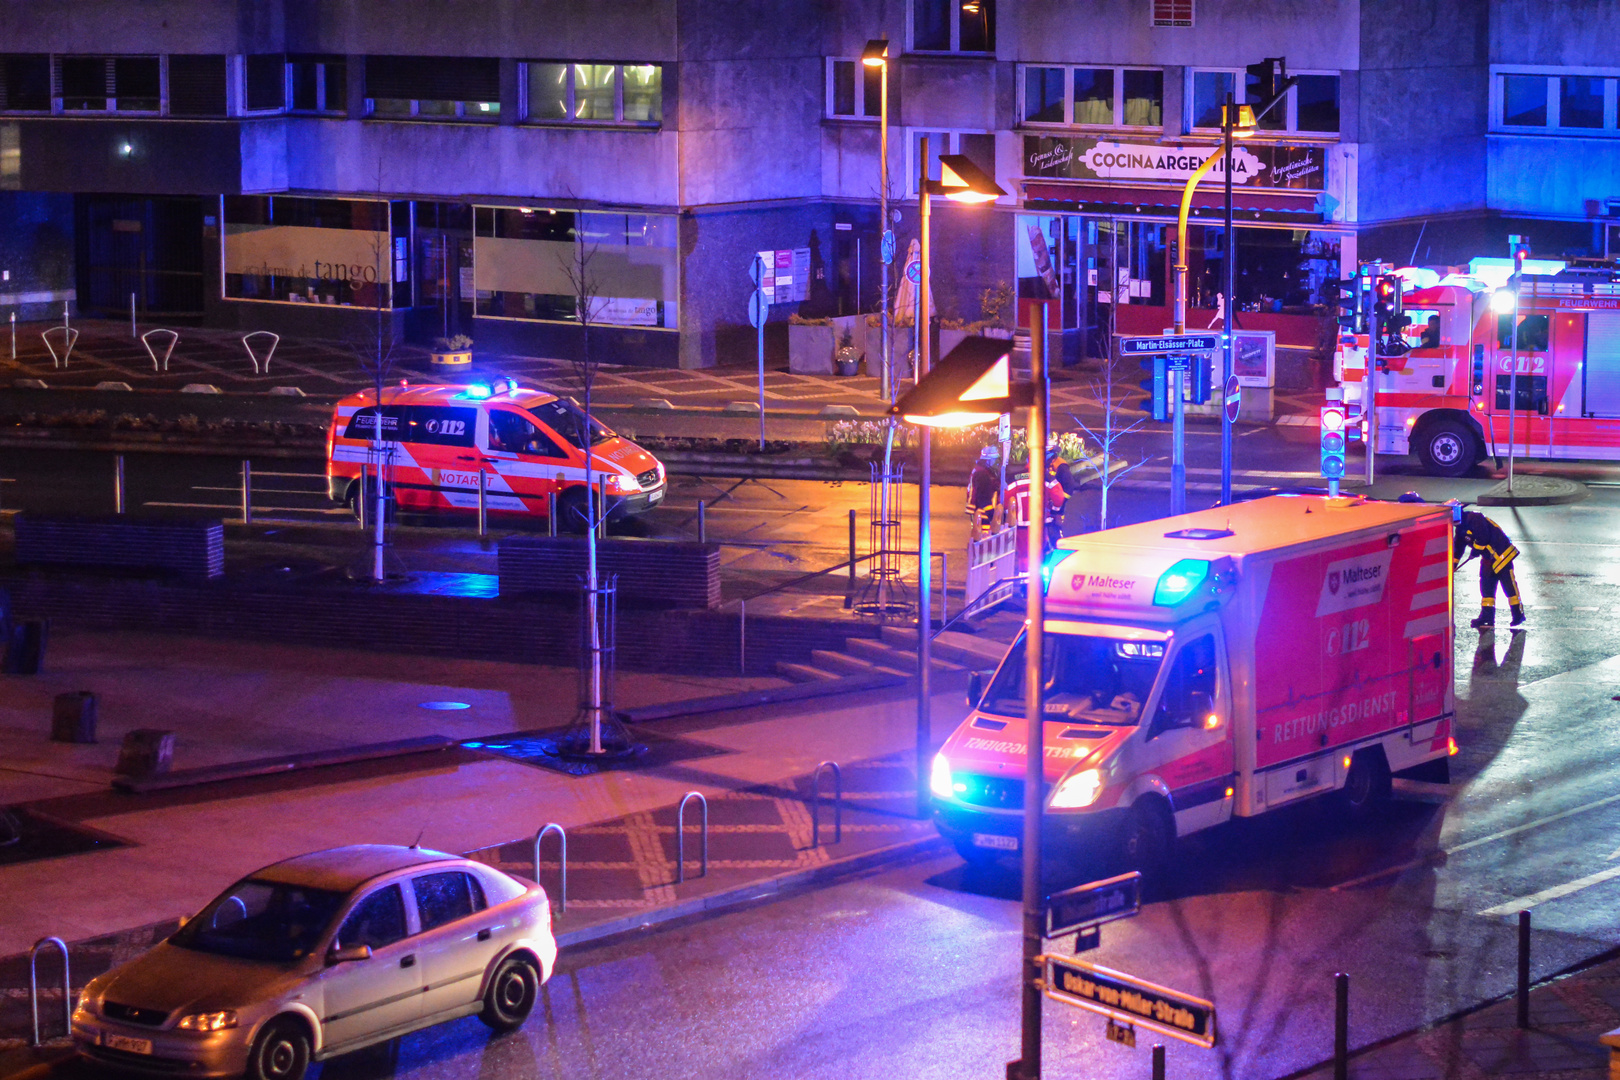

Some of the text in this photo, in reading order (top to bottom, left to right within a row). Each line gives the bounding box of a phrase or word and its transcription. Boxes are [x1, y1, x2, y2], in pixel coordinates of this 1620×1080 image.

[314, 259, 377, 290] tango
[1559, 299, 1618, 308] FEUERWEHR
[1136, 339, 1205, 350] Martin-Elsässer-Platz
[1516, 356, 1545, 374] 112
[439, 419, 465, 436] 112
[438, 473, 494, 487] NOTART
[1088, 575, 1136, 589] Malteser
[1342, 564, 1382, 585] Malteser
[1341, 619, 1370, 655] 112
[1274, 691, 1397, 744] RETTUNGSDIENST
